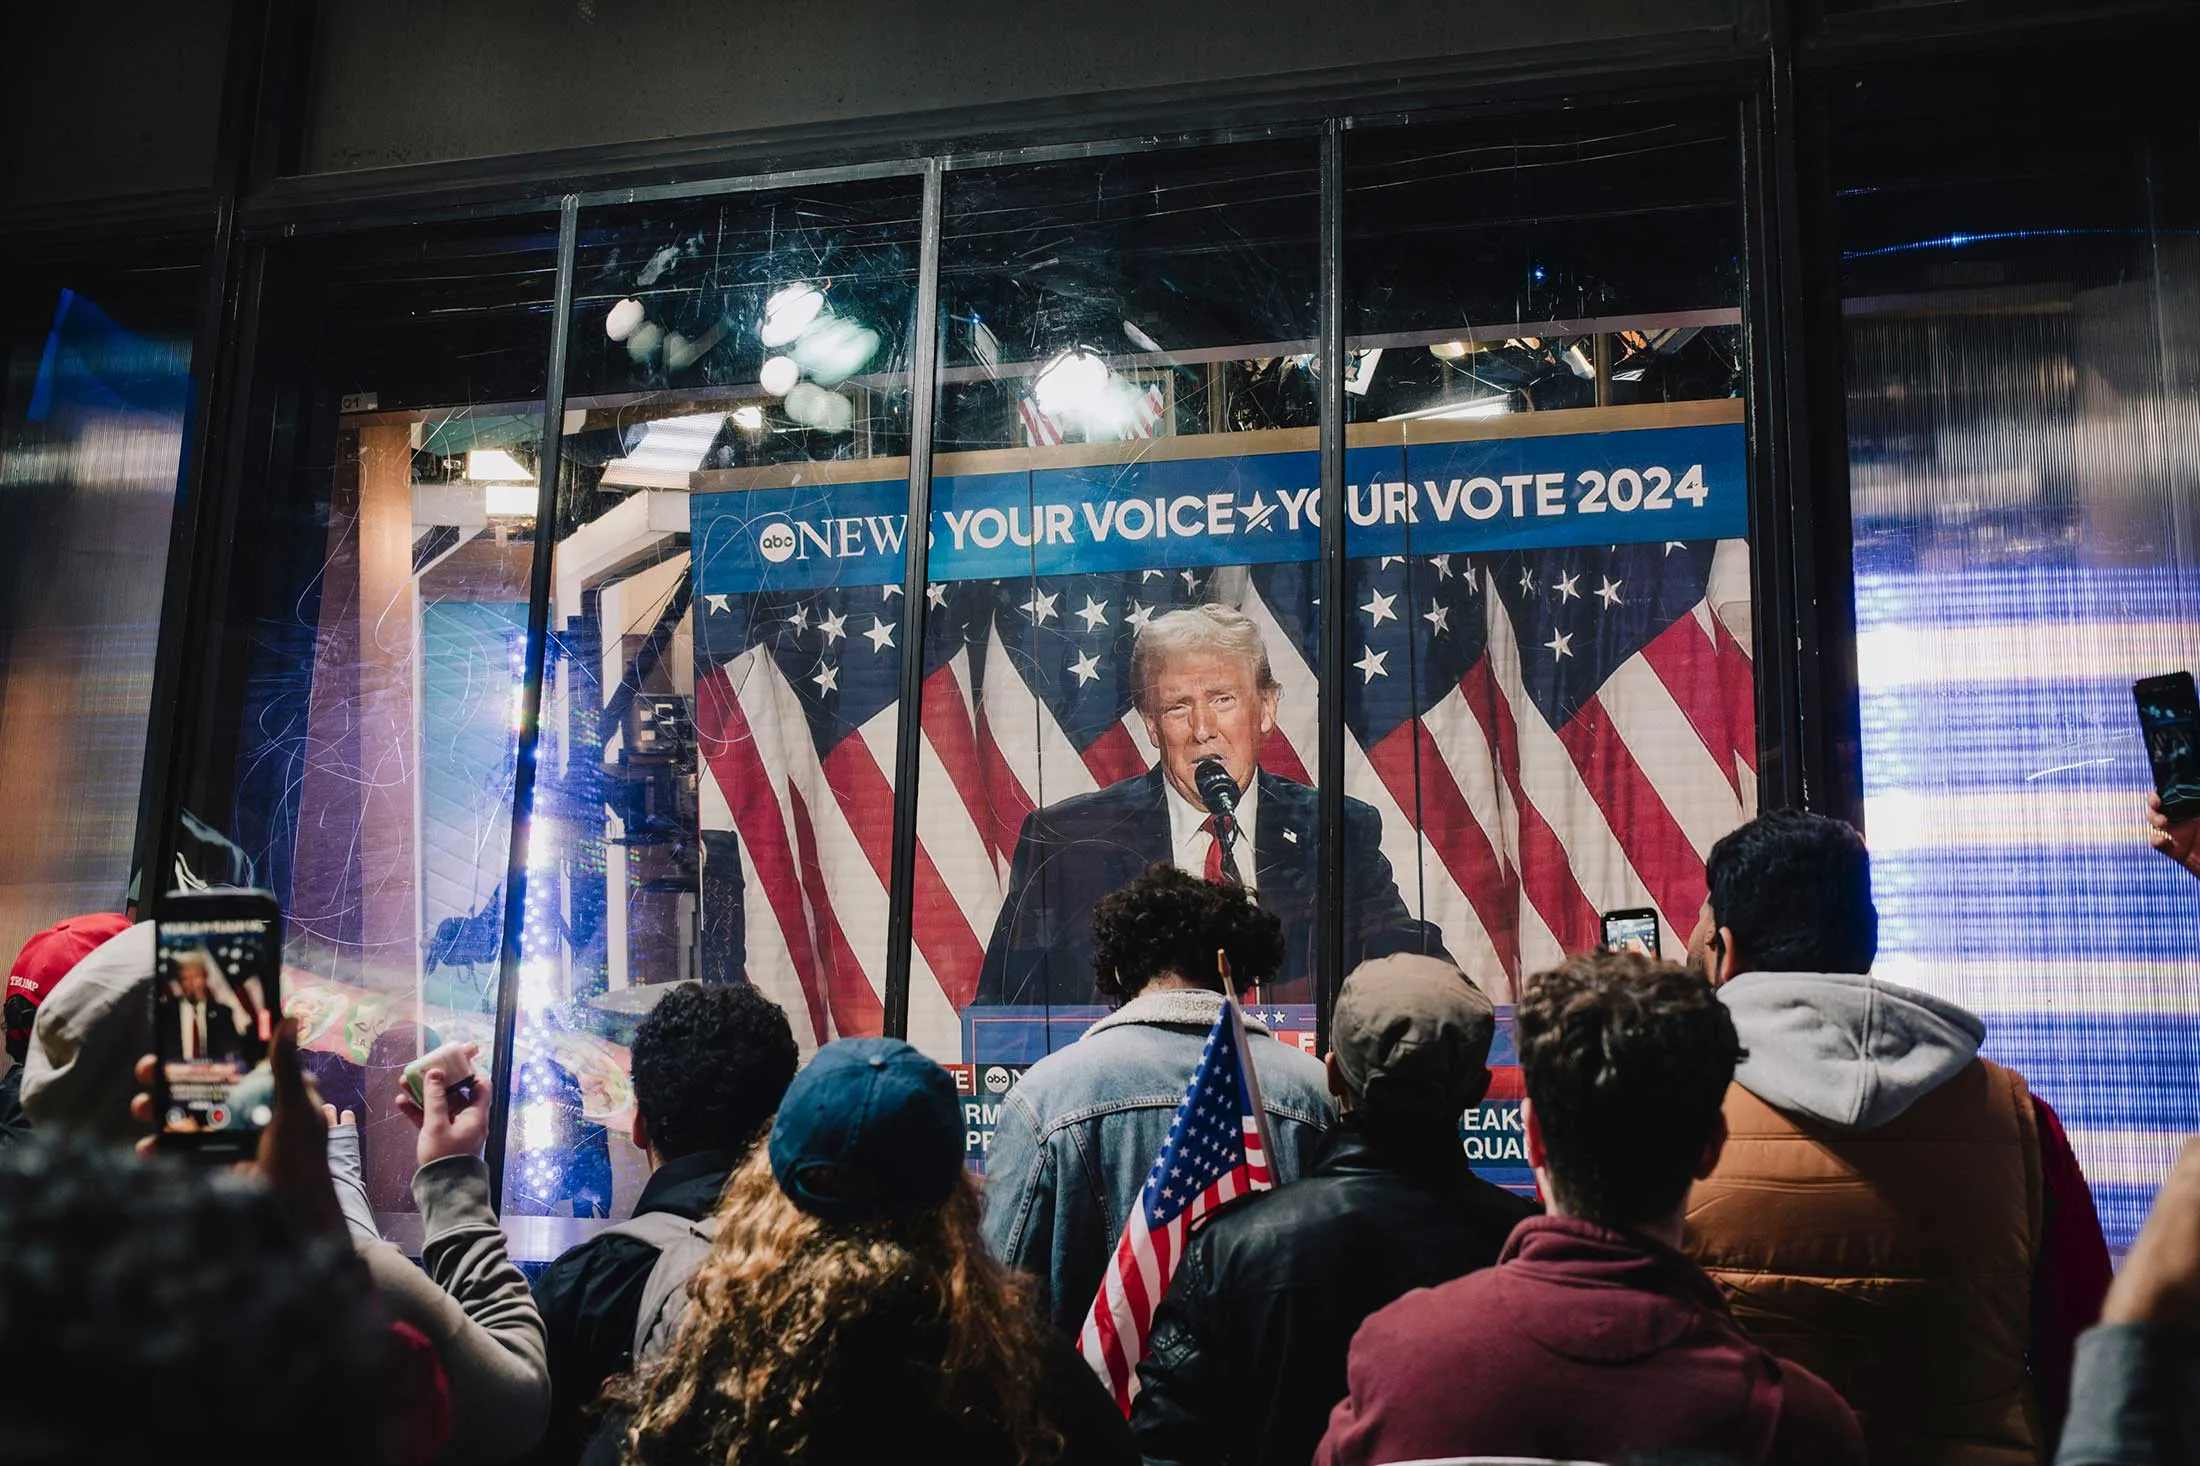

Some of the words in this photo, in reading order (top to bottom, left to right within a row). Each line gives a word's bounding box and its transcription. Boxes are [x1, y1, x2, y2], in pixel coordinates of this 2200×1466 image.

[762, 534, 793, 549] abc
[794, 514, 934, 560] NEW
[942, 504, 1075, 550] YOUR
[1082, 493, 1236, 542] VOICE
[1424, 472, 1567, 522] VOTE
[1576, 464, 1709, 514] 2024
[10, 975, 39, 992] TRUMP
[986, 1077, 1008, 1085] abc
